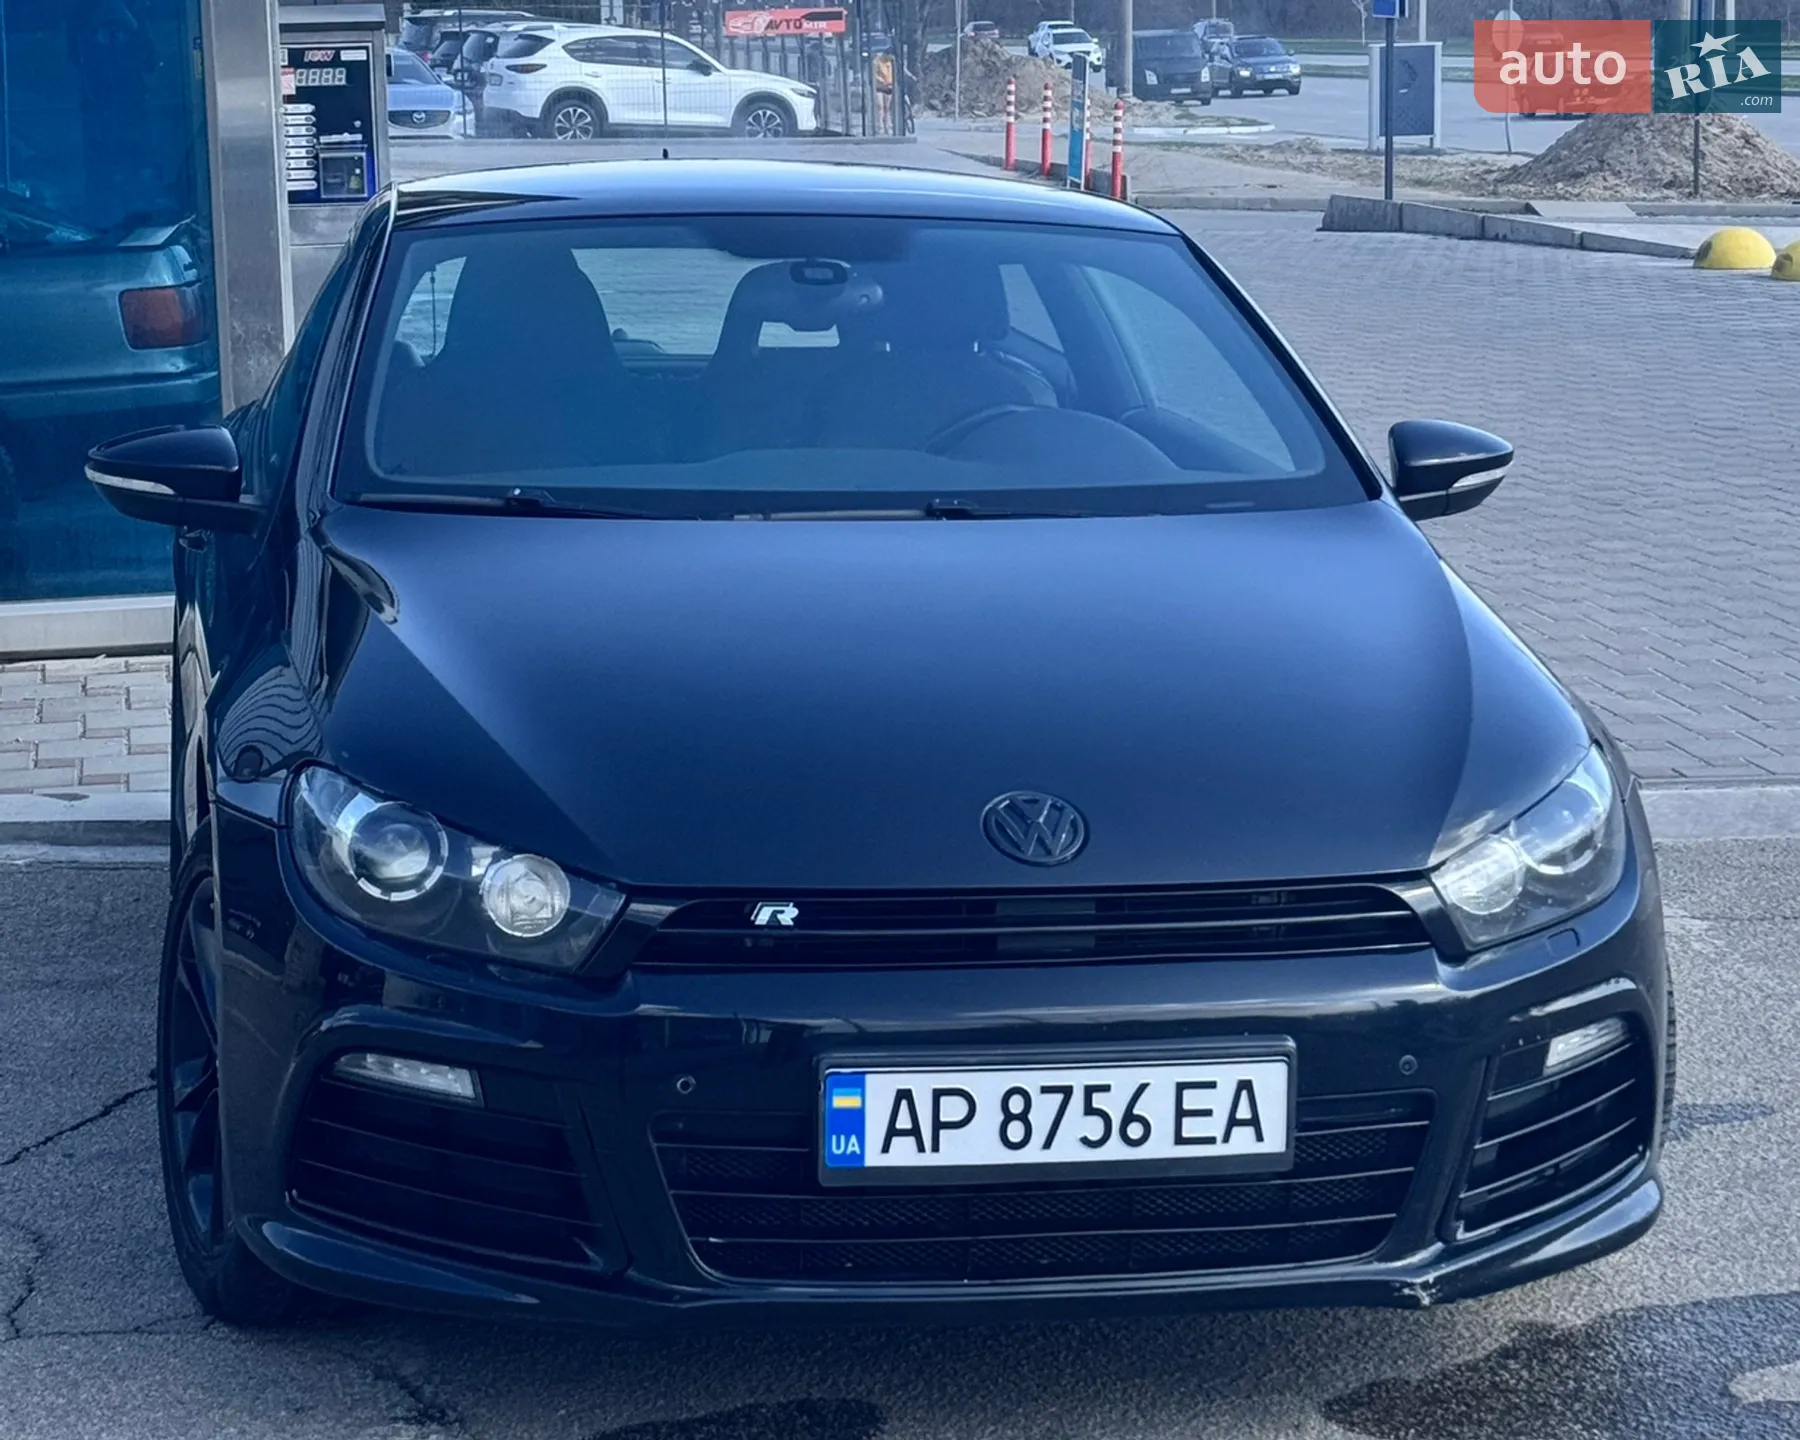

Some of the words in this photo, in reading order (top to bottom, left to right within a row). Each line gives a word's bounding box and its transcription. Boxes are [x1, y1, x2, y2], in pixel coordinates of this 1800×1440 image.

[750, 901, 799, 926] R
[880, 1087, 977, 1154] AP
[998, 1082, 1152, 1150] 8756
[1174, 1078, 1264, 1146] EA
[831, 1134, 861, 1155] UA
